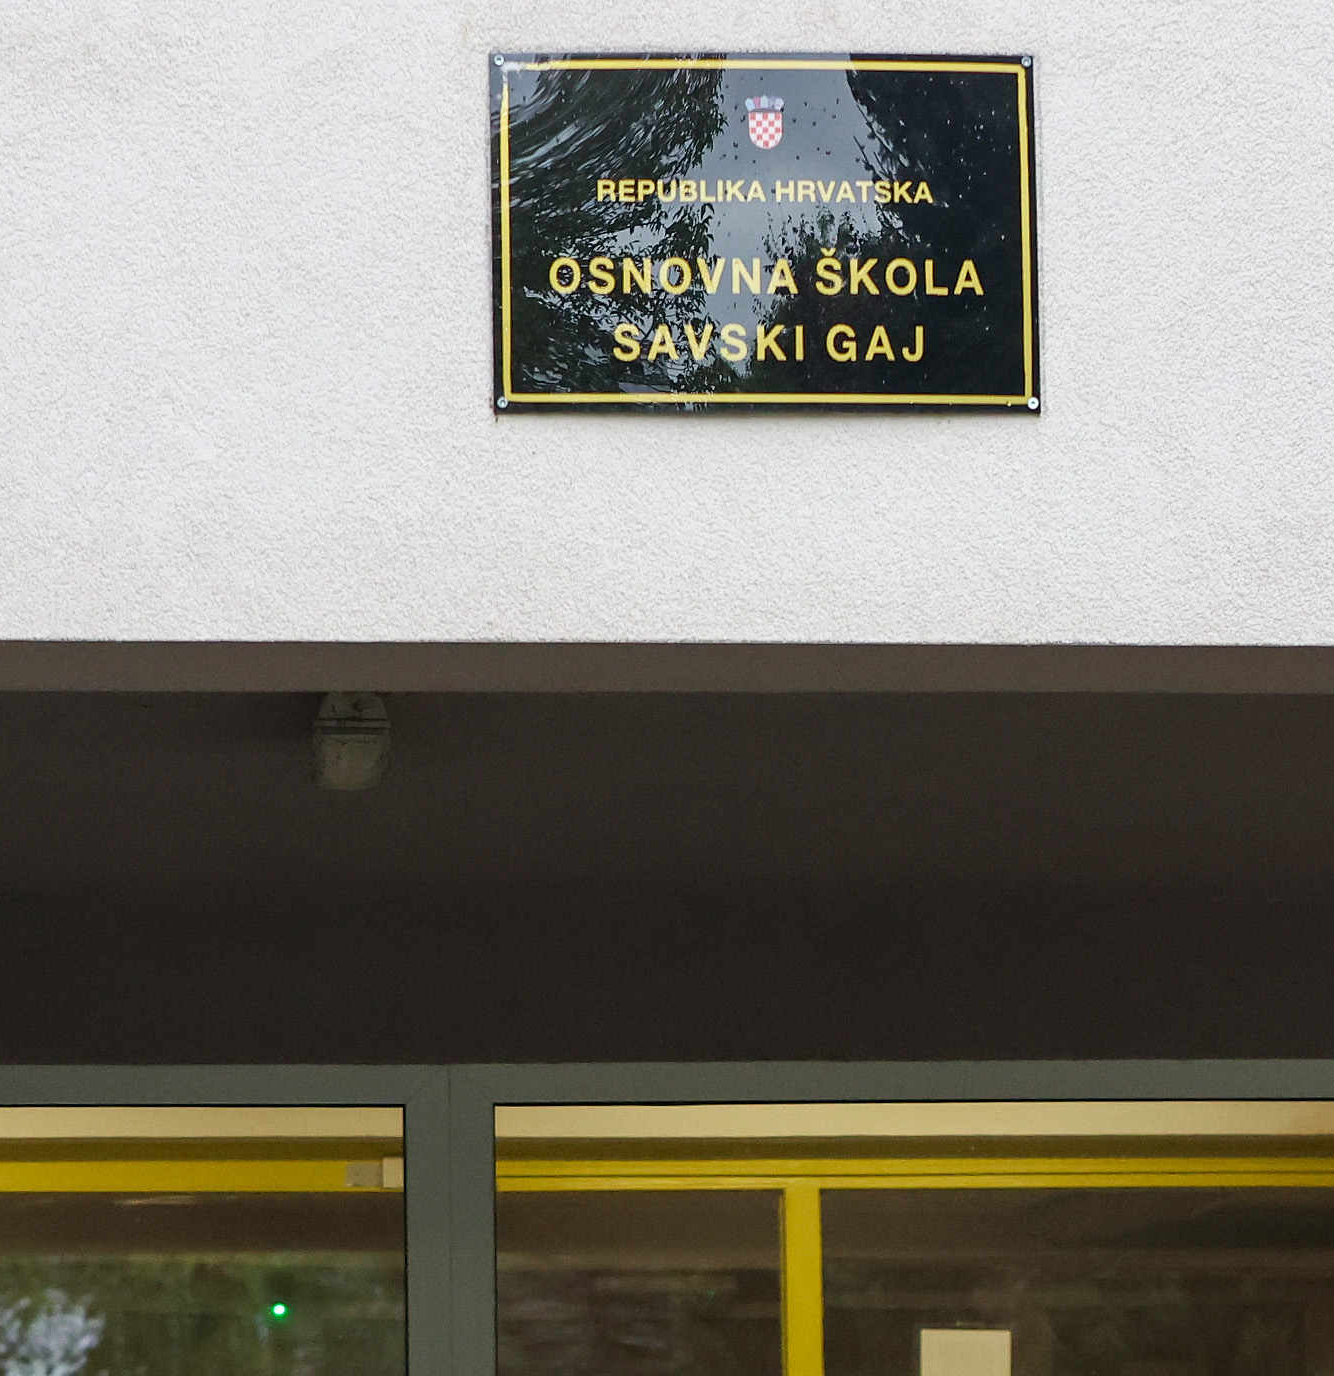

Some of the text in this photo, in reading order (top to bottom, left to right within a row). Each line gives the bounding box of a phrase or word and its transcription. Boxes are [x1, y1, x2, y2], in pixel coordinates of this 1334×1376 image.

[596, 179, 934, 204] REPUBLIKA HRVATSKA
[548, 247, 985, 296] OSNOVNA ŠKOLA
[613, 322, 925, 362] SAVSKI GAJ
